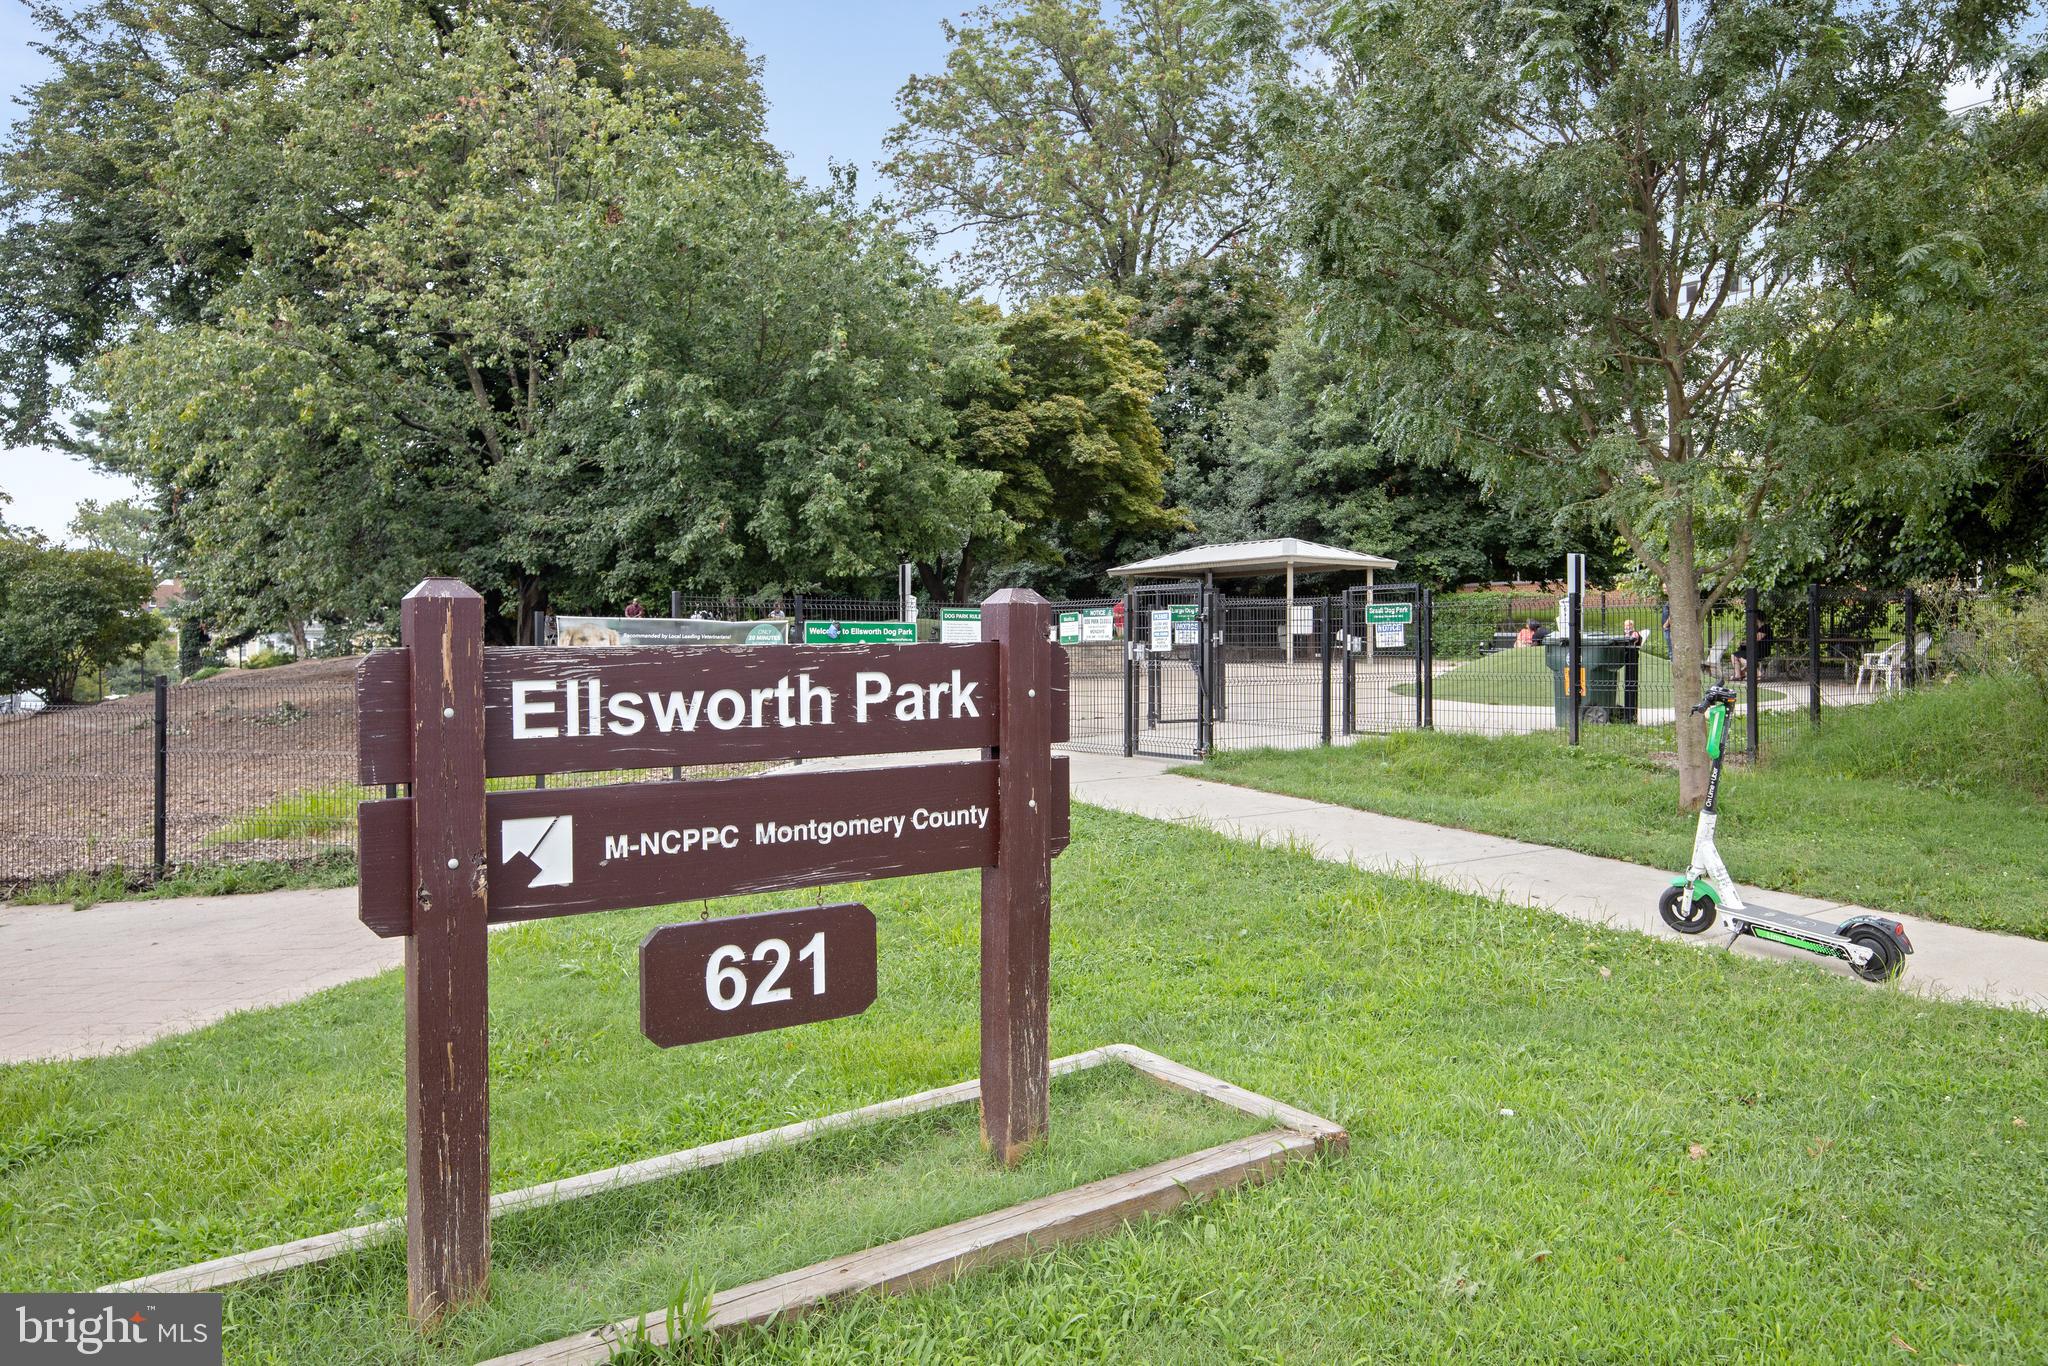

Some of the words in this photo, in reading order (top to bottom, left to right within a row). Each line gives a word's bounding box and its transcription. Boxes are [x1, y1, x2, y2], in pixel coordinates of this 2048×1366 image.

[682, 633, 700, 641] Leading
[850, 627, 882, 635] Ellsworth
[883, 628, 897, 637] Dog
[512, 672, 832, 740] Ellsworth
[855, 668, 980, 724] Park
[605, 824, 739, 861] M-NCPPC
[755, 814, 906, 846] Montgomery
[911, 804, 990, 831] County
[704, 931, 827, 1013] 621
